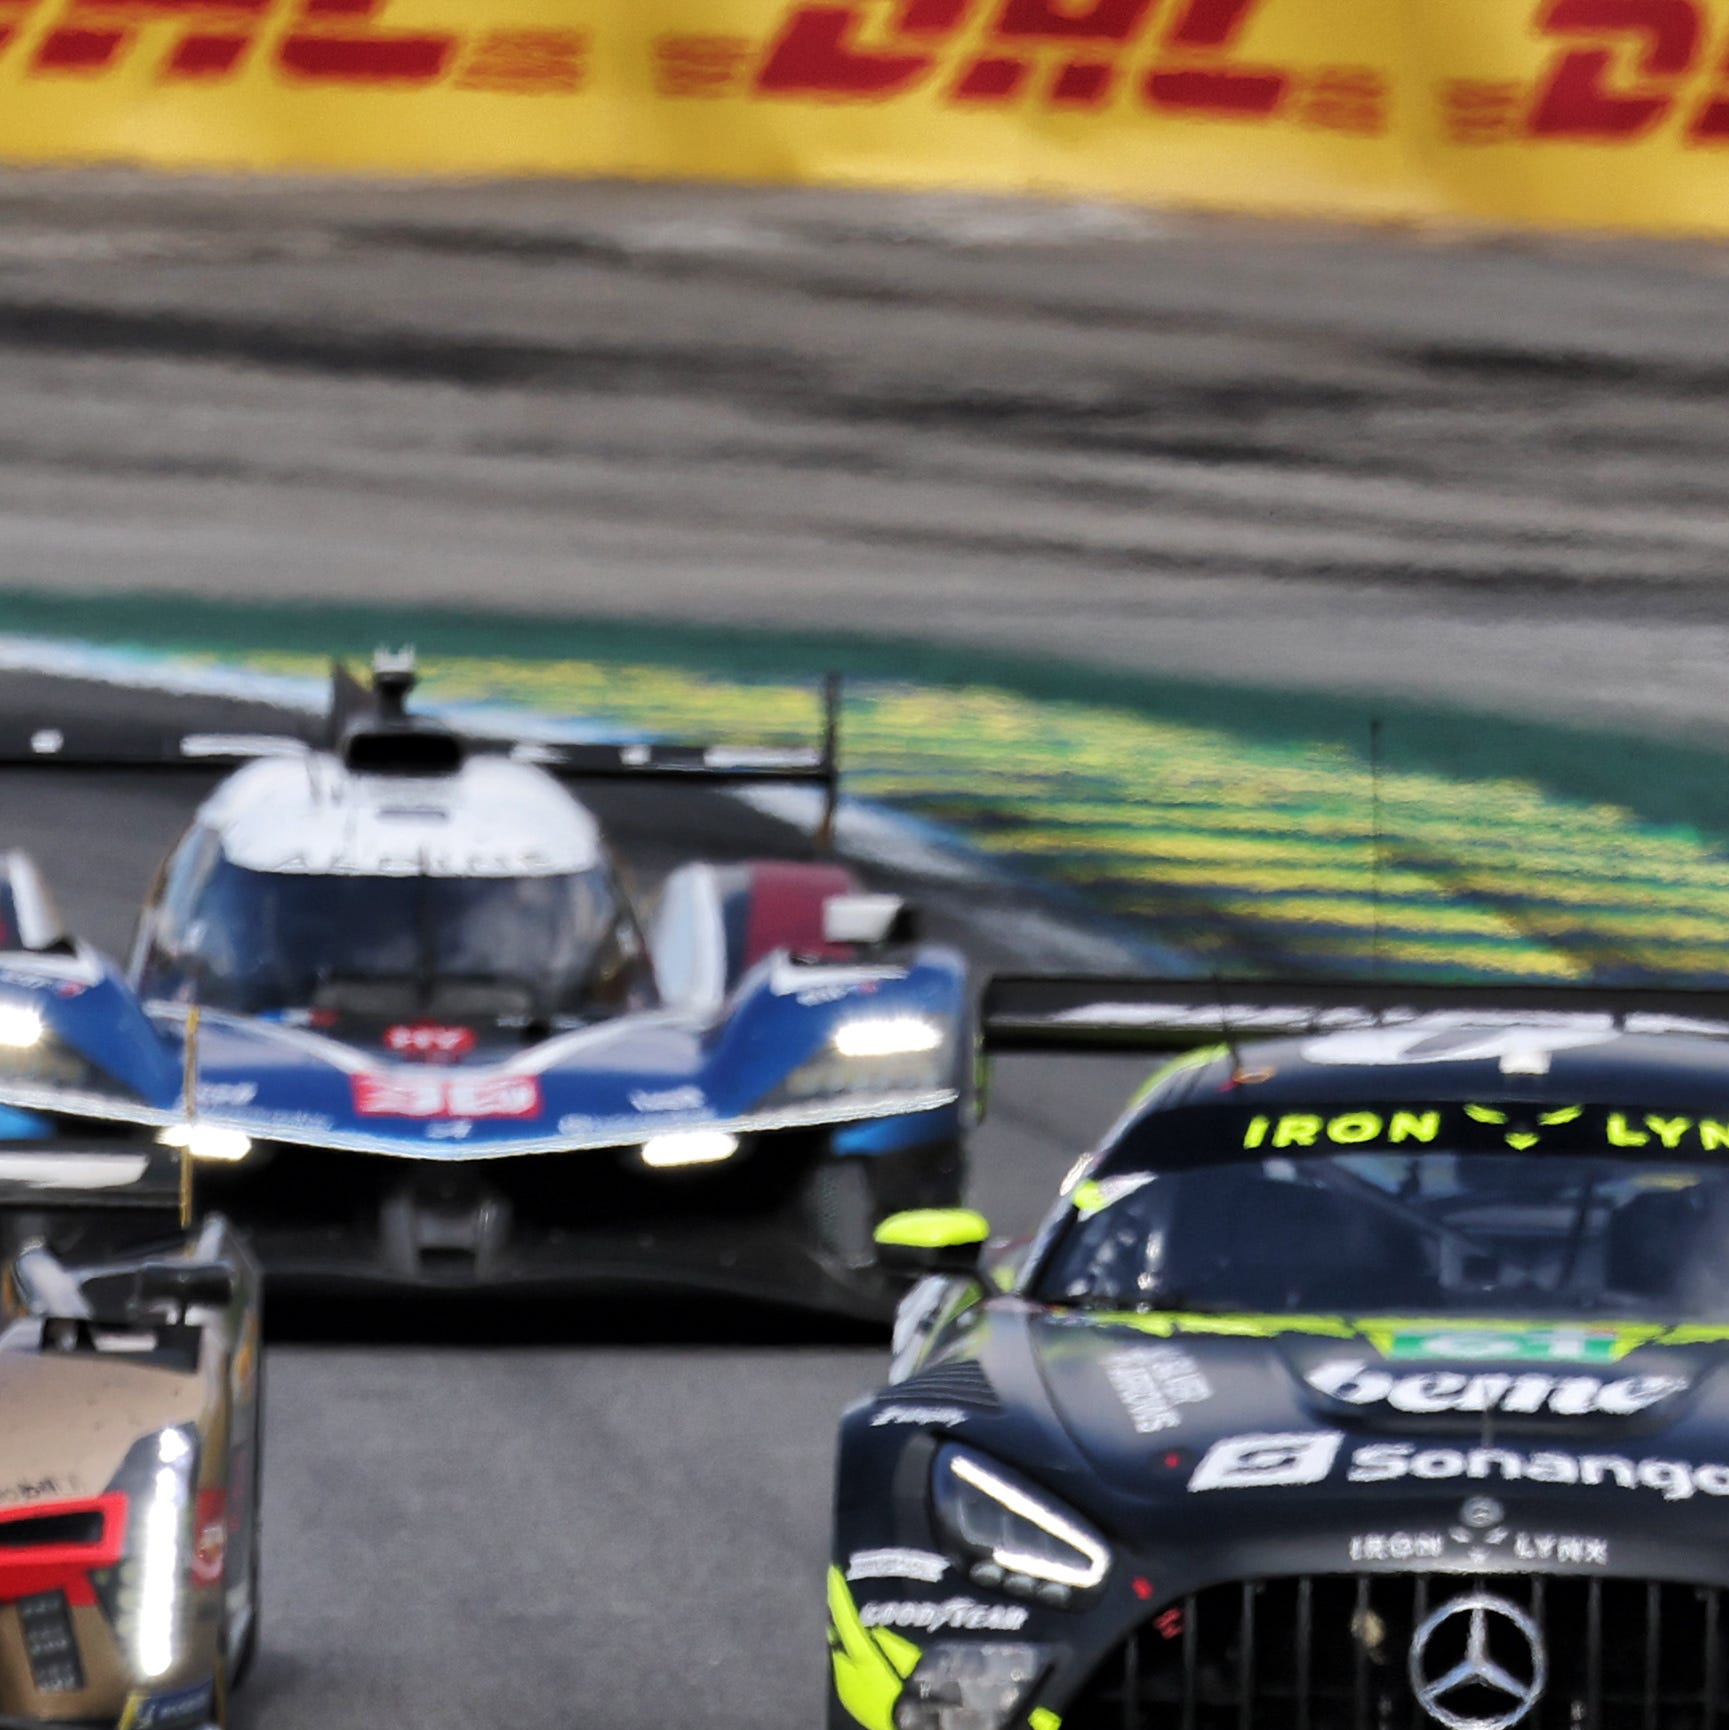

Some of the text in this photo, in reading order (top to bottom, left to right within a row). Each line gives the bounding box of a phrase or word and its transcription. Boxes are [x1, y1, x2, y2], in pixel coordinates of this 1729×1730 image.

[1243, 1111, 1441, 1149] IRON
[1349, 1531, 1608, 1565] IRON LYNX
